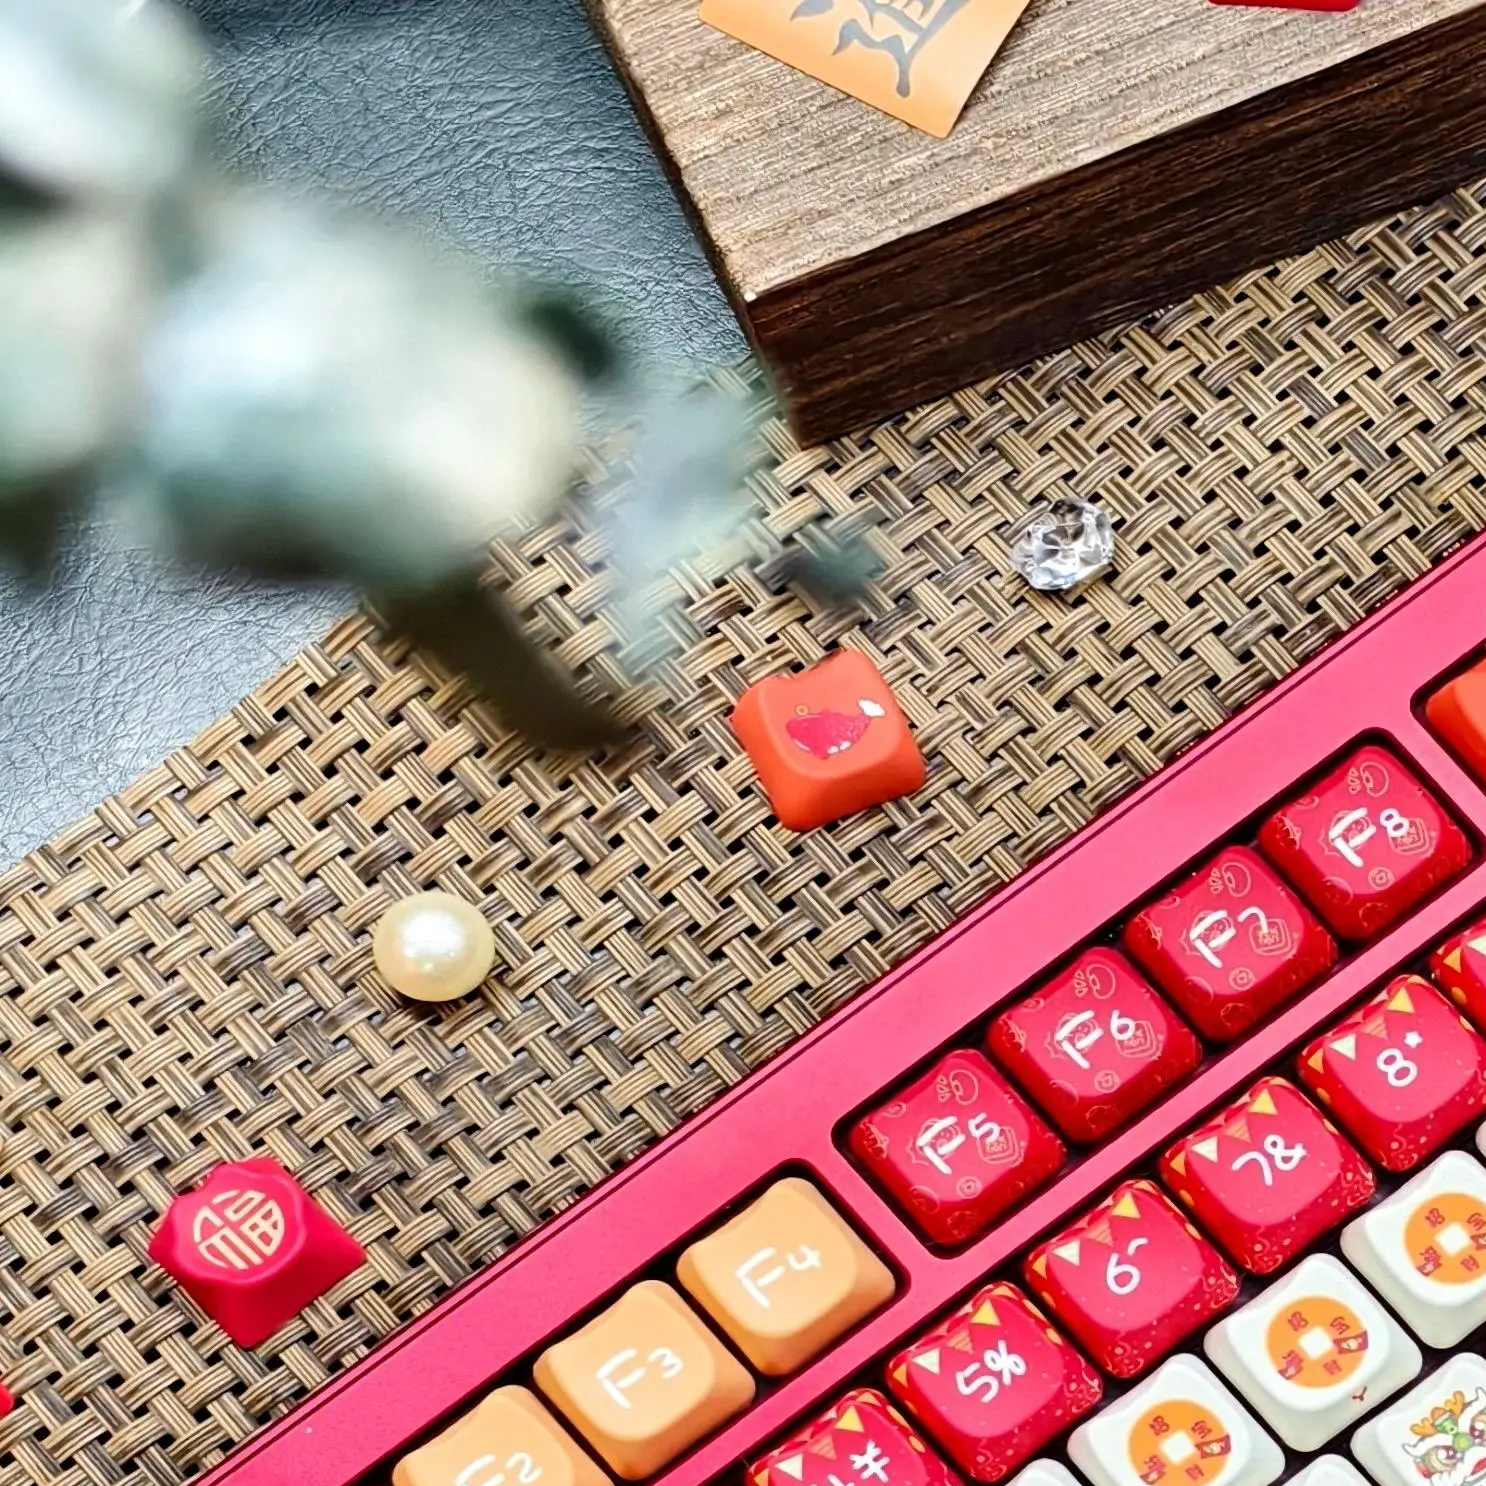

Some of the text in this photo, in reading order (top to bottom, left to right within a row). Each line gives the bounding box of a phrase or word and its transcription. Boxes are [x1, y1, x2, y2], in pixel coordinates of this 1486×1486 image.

[1329, 808, 1409, 866] F8
[1190, 908, 1268, 967] F7
[1056, 1011, 1134, 1068] F6
[917, 1114, 1000, 1173] F5
[735, 1245, 821, 1310] F4
[594, 1347, 683, 1410] F3
[957, 1341, 1025, 1402] 5%
